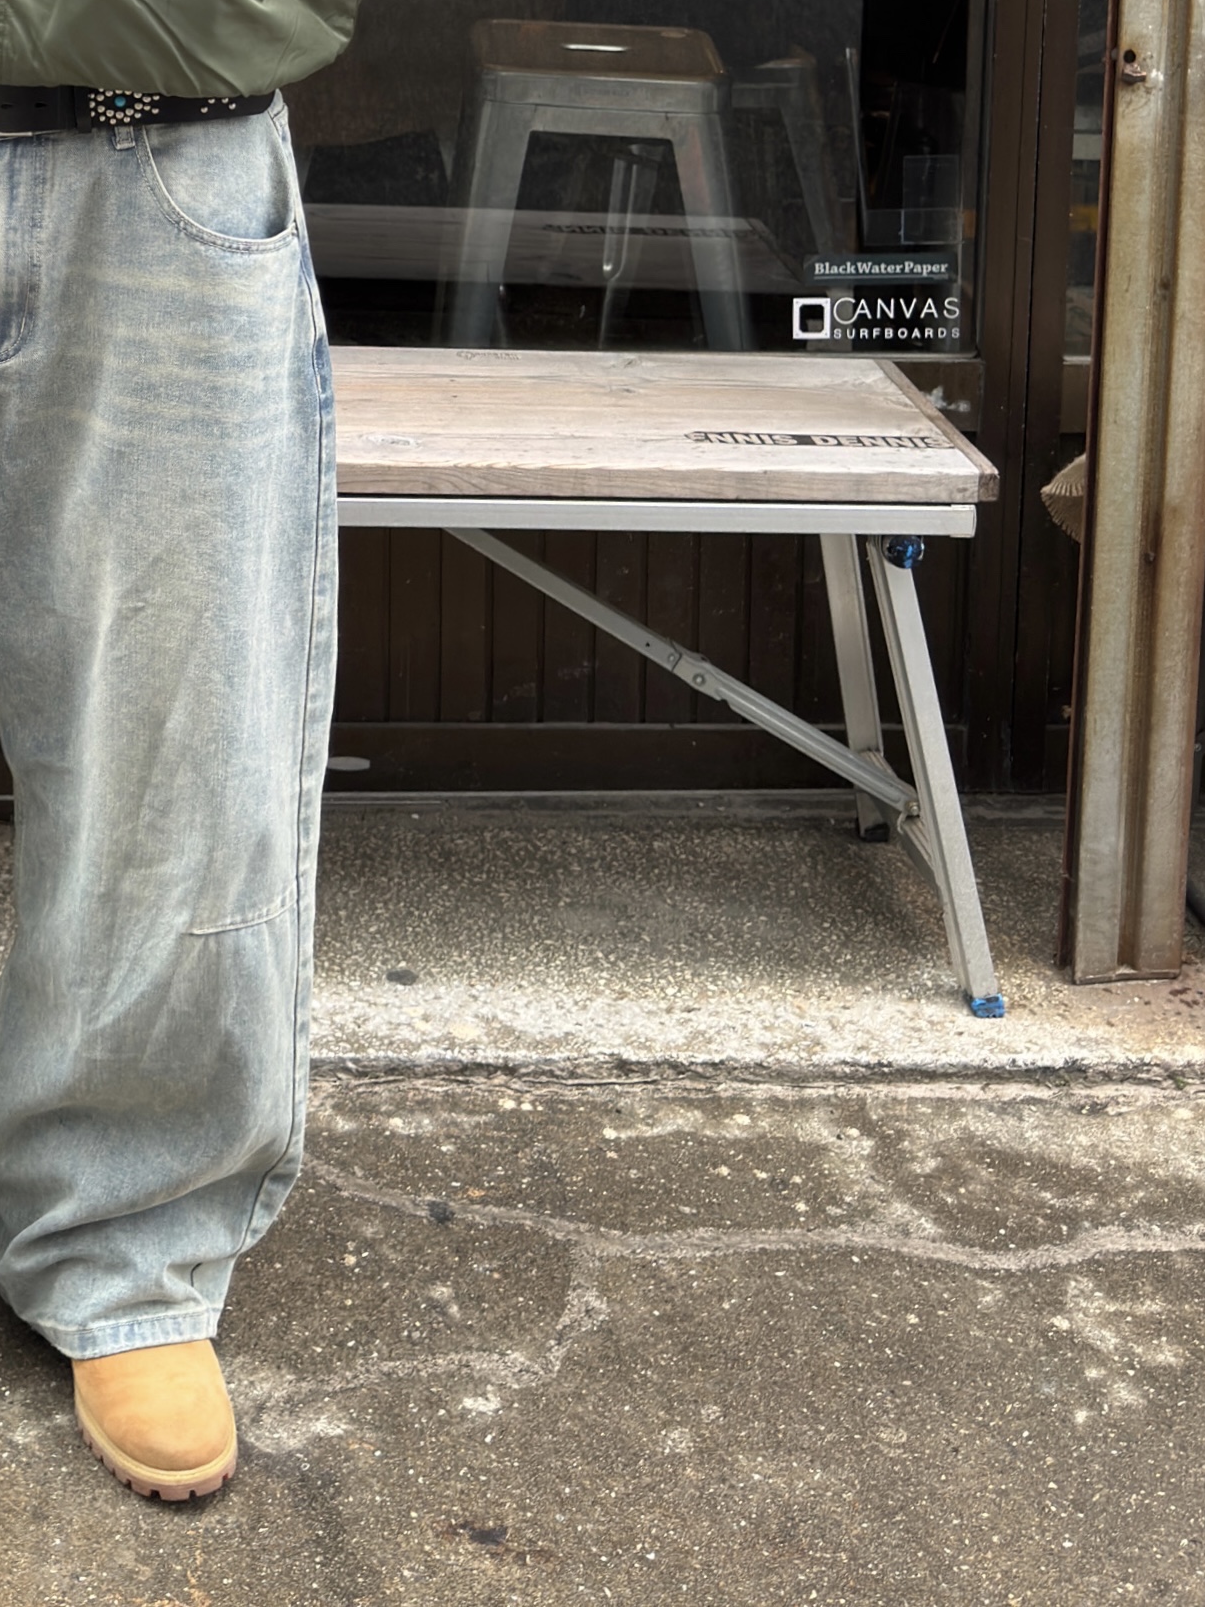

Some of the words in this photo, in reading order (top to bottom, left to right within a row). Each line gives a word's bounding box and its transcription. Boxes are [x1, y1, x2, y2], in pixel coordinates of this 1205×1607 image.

[833, 297, 960, 325] CANVAS
[833, 327, 960, 339] SURFBOARDS
[810, 435, 955, 448] DENNIS
